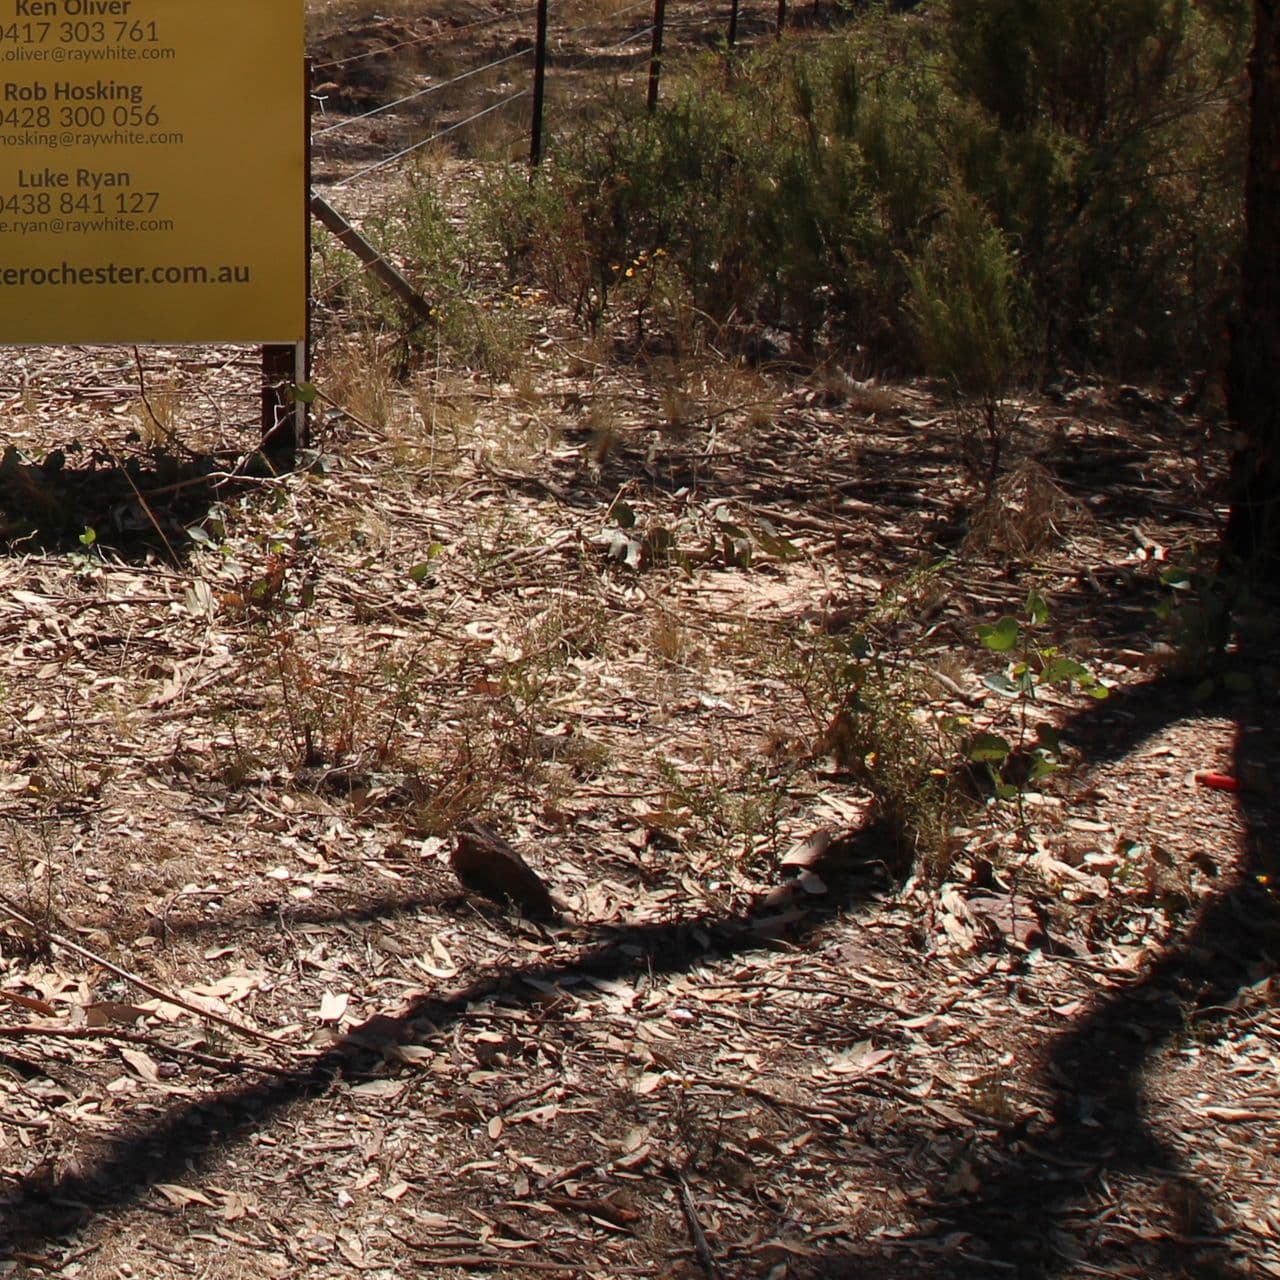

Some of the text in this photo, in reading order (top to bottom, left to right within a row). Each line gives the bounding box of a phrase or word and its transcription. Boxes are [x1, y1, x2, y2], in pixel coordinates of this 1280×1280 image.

[59, 22, 105, 43] 303
[115, 21, 158, 42] 761
[4, 81, 143, 103] Rob Hosking
[59, 107, 106, 128] 300
[113, 105, 159, 127] 056
[18, 169, 130, 191] Luke Ryan
[59, 193, 104, 214] 841
[116, 192, 159, 214] 127
